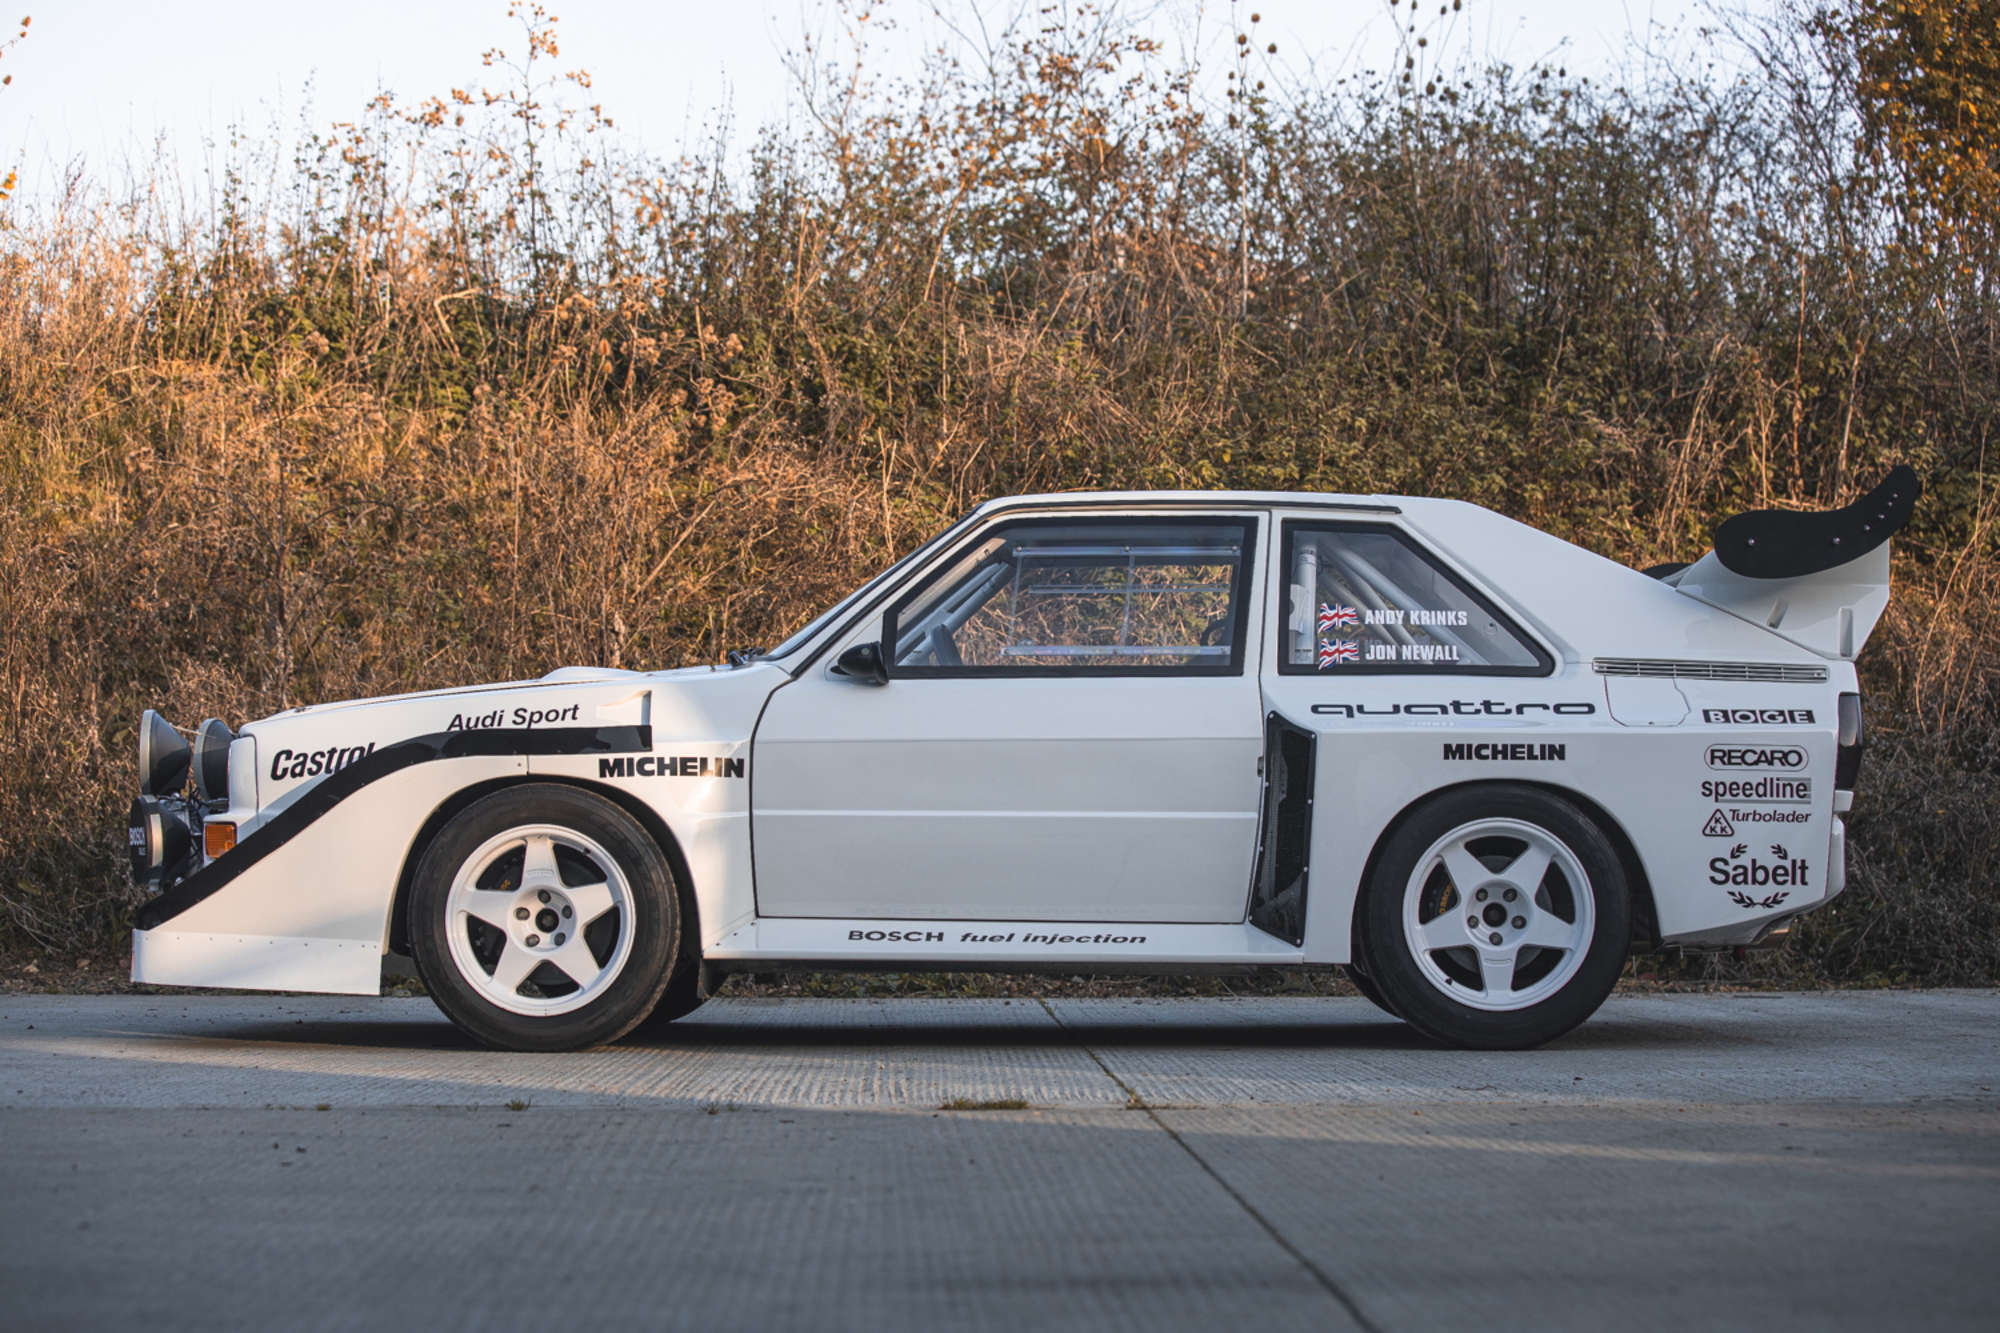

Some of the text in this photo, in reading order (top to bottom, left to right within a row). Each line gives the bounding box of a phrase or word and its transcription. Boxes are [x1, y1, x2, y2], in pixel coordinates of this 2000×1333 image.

[1365, 610, 1467, 626] ANDY KRINKS
[1366, 645, 1459, 660] JON NEWALL
[447, 704, 580, 731] Audi Sport
[1310, 700, 1596, 718] quattro
[1702, 709, 1816, 724] BOGE
[1443, 744, 1566, 760] MICHELIN
[1710, 749, 1803, 767] RECARO
[599, 757, 744, 778] MICHELIN
[1701, 777, 1808, 803] speedline
[1729, 809, 1812, 823] Turbolader
[1709, 857, 1809, 886] Sabelt
[848, 930, 1147, 945] BOSCH fuel injection
